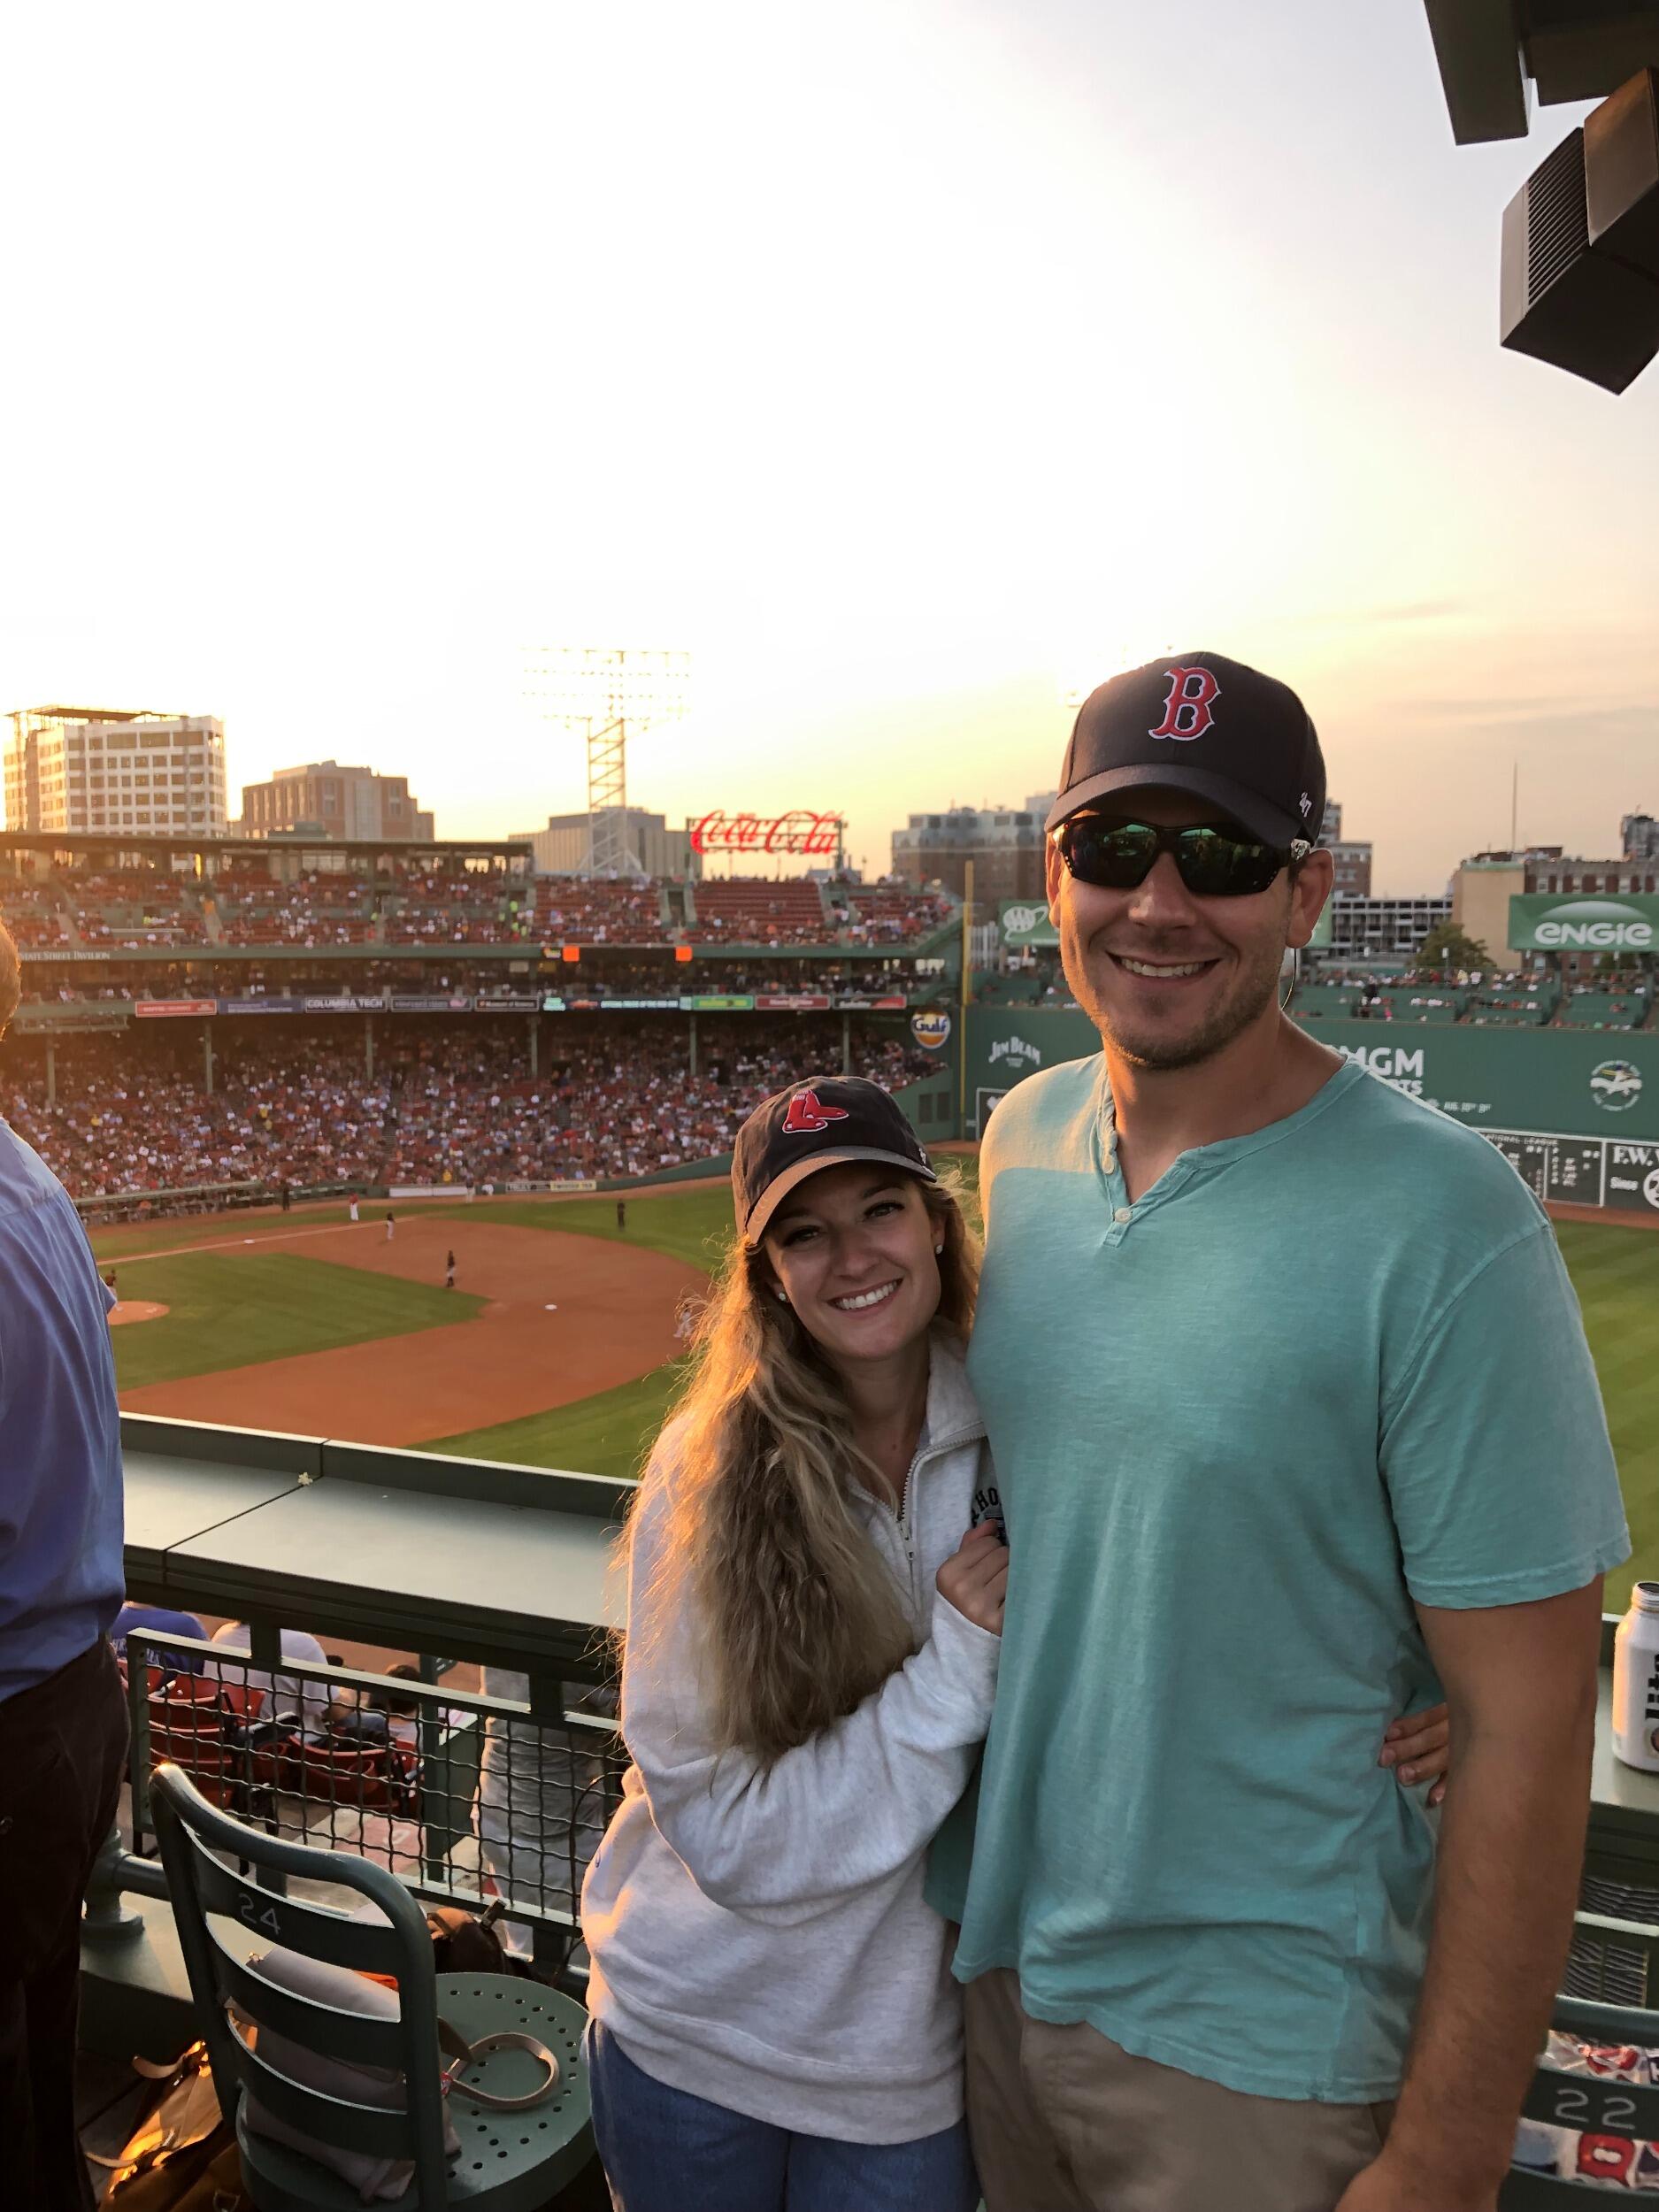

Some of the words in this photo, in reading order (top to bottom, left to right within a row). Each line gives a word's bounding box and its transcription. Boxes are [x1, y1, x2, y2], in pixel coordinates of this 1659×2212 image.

[1148, 667, 1222, 741] B
[691, 810, 842, 854] Coca-Cola
[358, 998, 383, 1009] TECH
[913, 1018, 948, 1033] Gulf
[1613, 1146, 1653, 1166] F.W.
[239, 1893, 280, 1935] 24
[1555, 2089, 1636, 2131] 22
